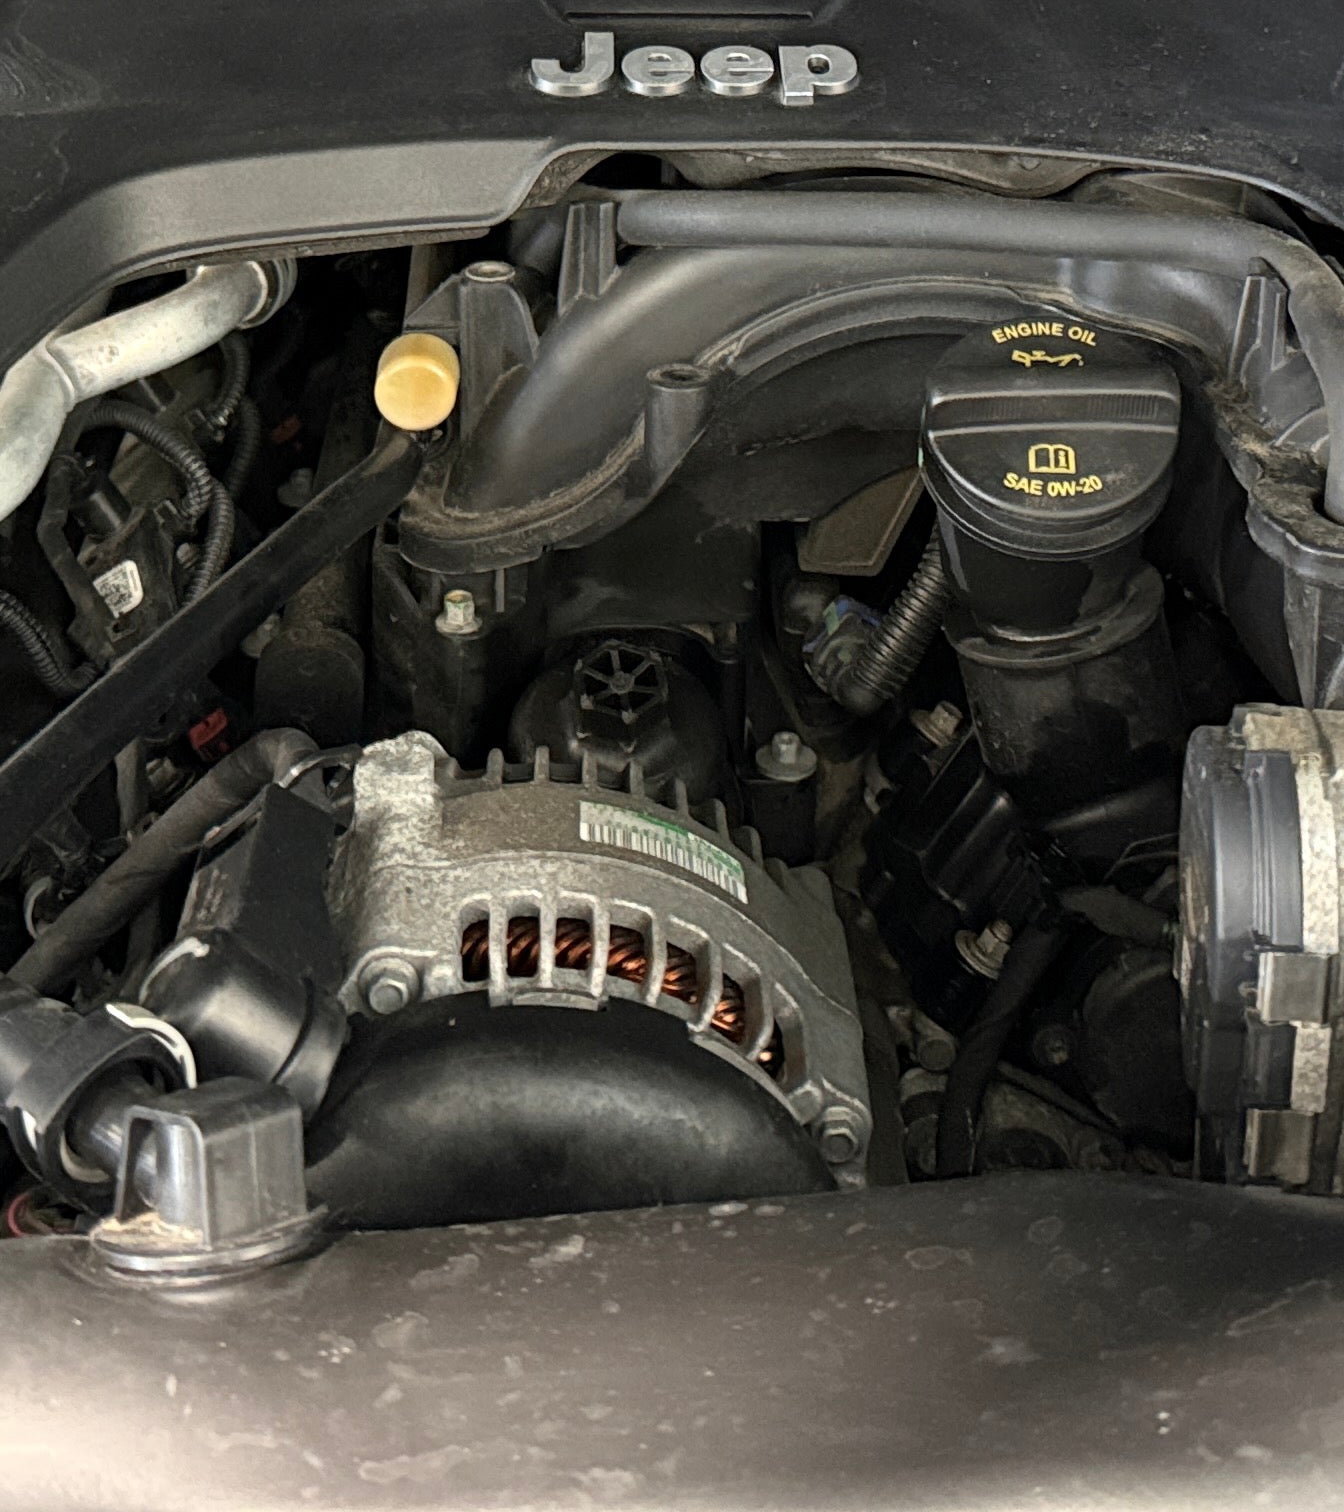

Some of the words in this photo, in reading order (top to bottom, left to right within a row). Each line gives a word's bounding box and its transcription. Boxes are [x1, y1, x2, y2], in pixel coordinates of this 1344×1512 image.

[529, 31, 858, 106] Jeep
[991, 321, 1064, 344] ENGINE
[1067, 326, 1098, 347] OIL
[1003, 471, 1044, 497] SAE
[1046, 474, 1103, 498] 0W-20
